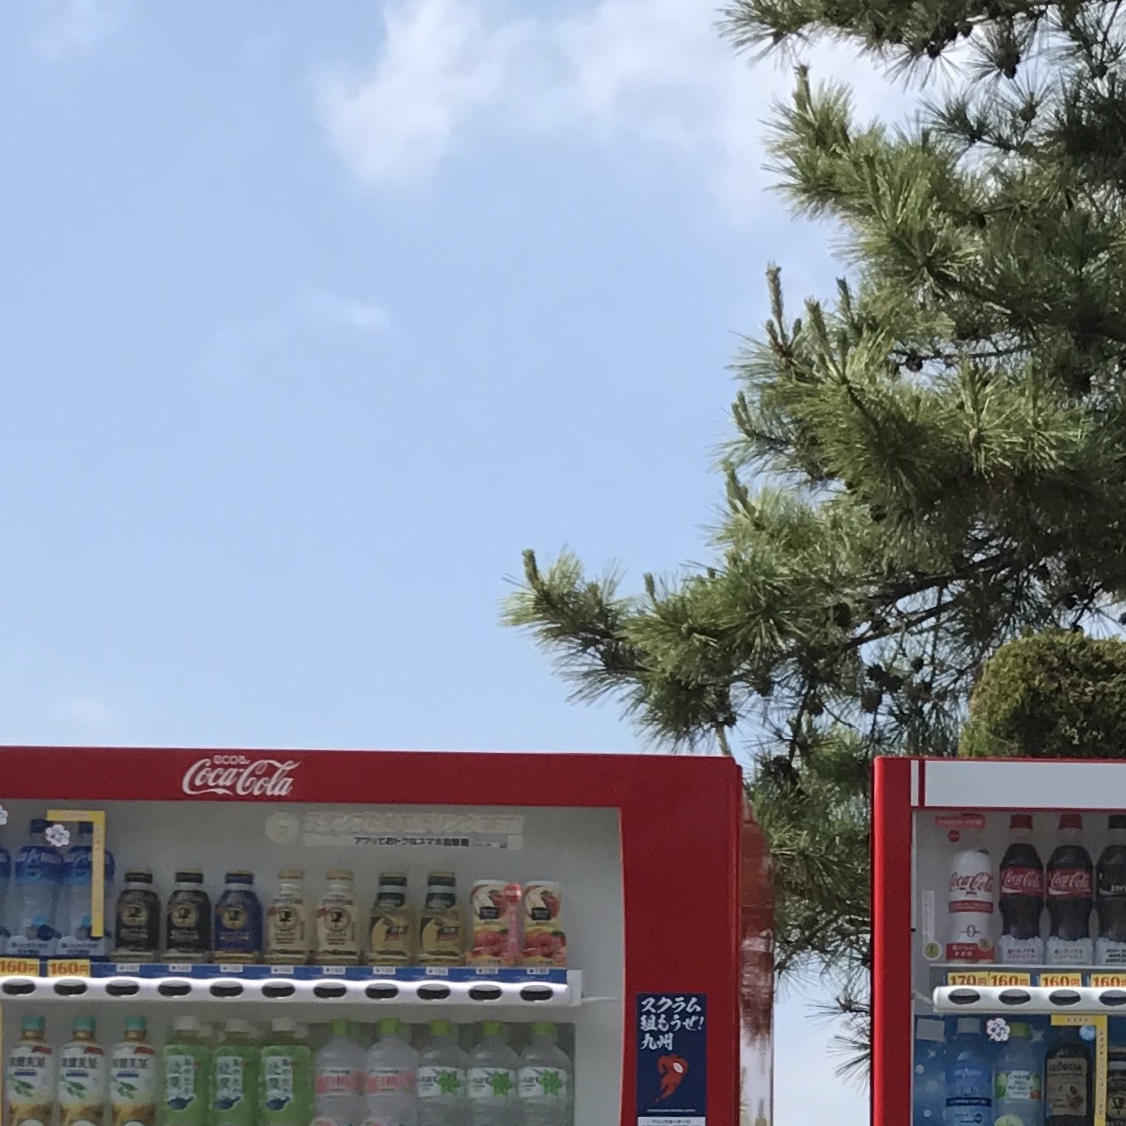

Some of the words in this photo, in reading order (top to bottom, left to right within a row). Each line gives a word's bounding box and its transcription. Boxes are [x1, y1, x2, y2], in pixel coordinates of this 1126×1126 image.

[182, 758, 301, 796] Coca-Cola
[641, 996, 702, 1013] スクラム
[640, 1033, 674, 1051] 九州
